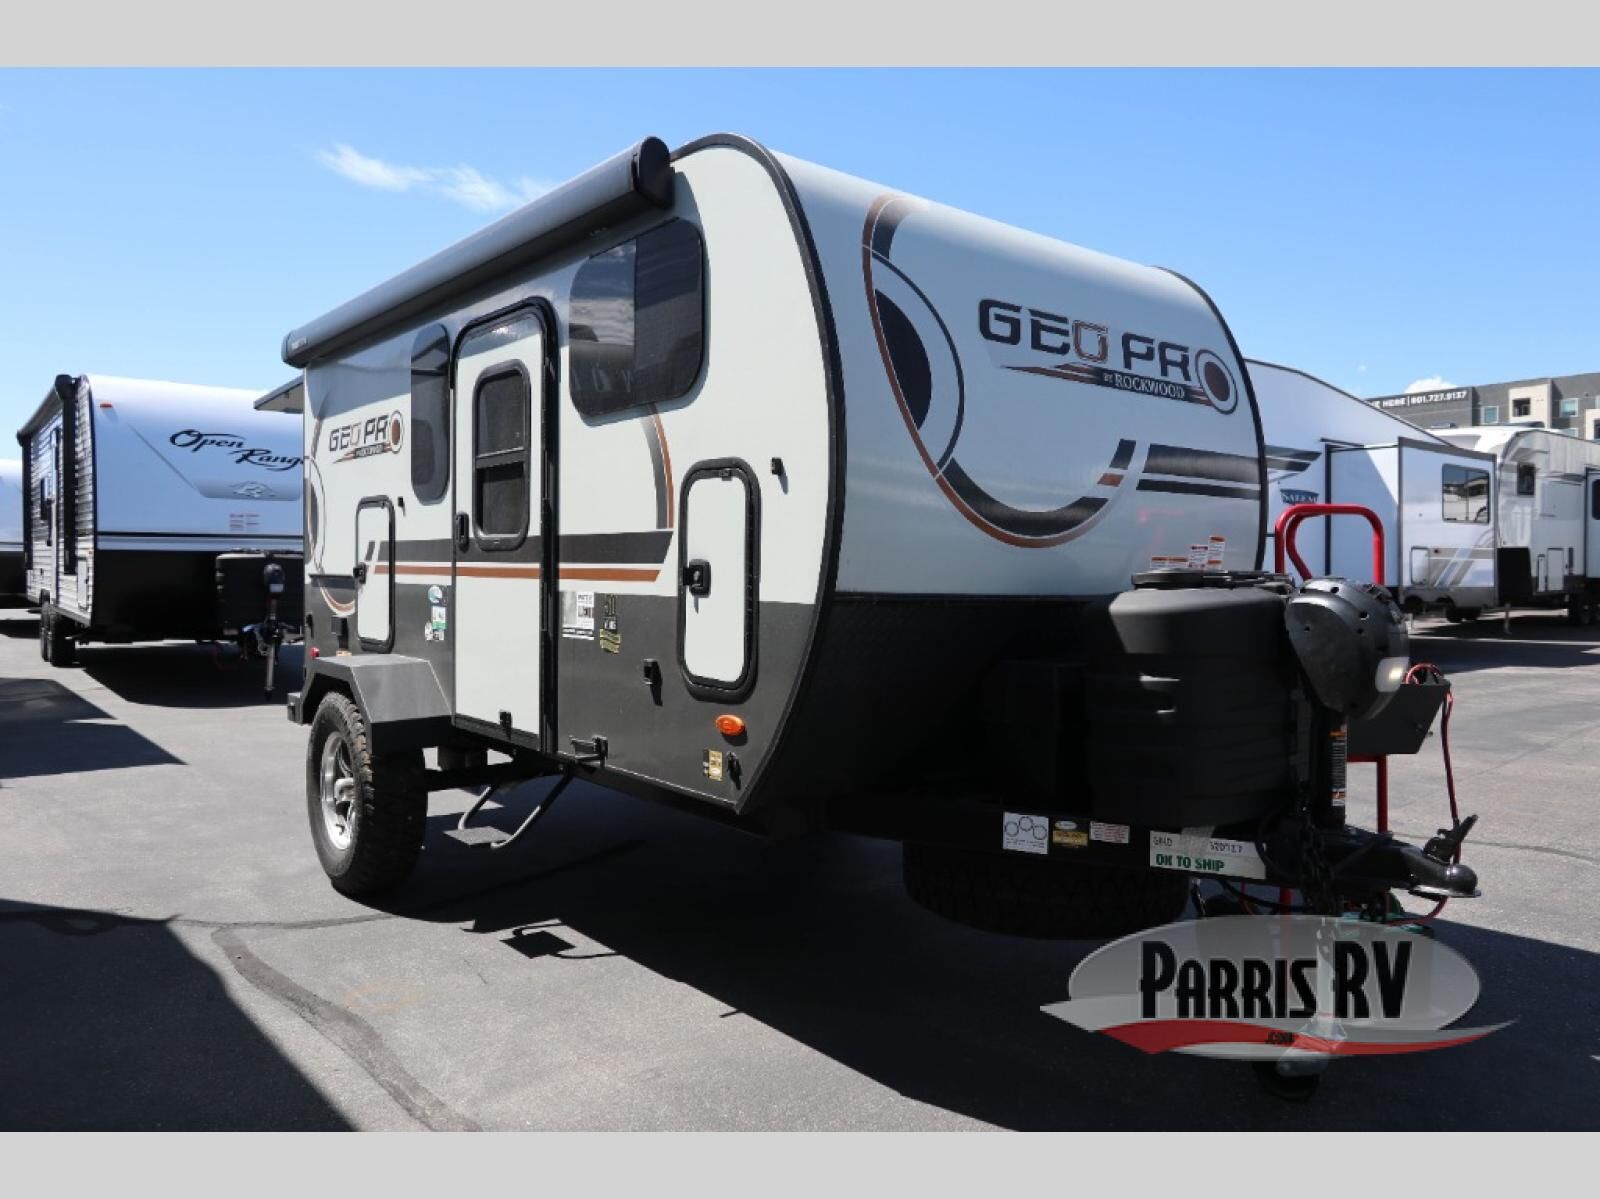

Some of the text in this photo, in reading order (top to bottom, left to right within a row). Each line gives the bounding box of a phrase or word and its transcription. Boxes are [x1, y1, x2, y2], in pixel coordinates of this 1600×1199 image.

[978, 298, 1109, 364] GEO
[1115, 375, 1186, 400] ROCKWOOD
[169, 429, 247, 453] Open
[329, 422, 362, 452] GEO
[228, 448, 304, 472] Rang
[1155, 853, 1225, 872] OK TO SHIP
